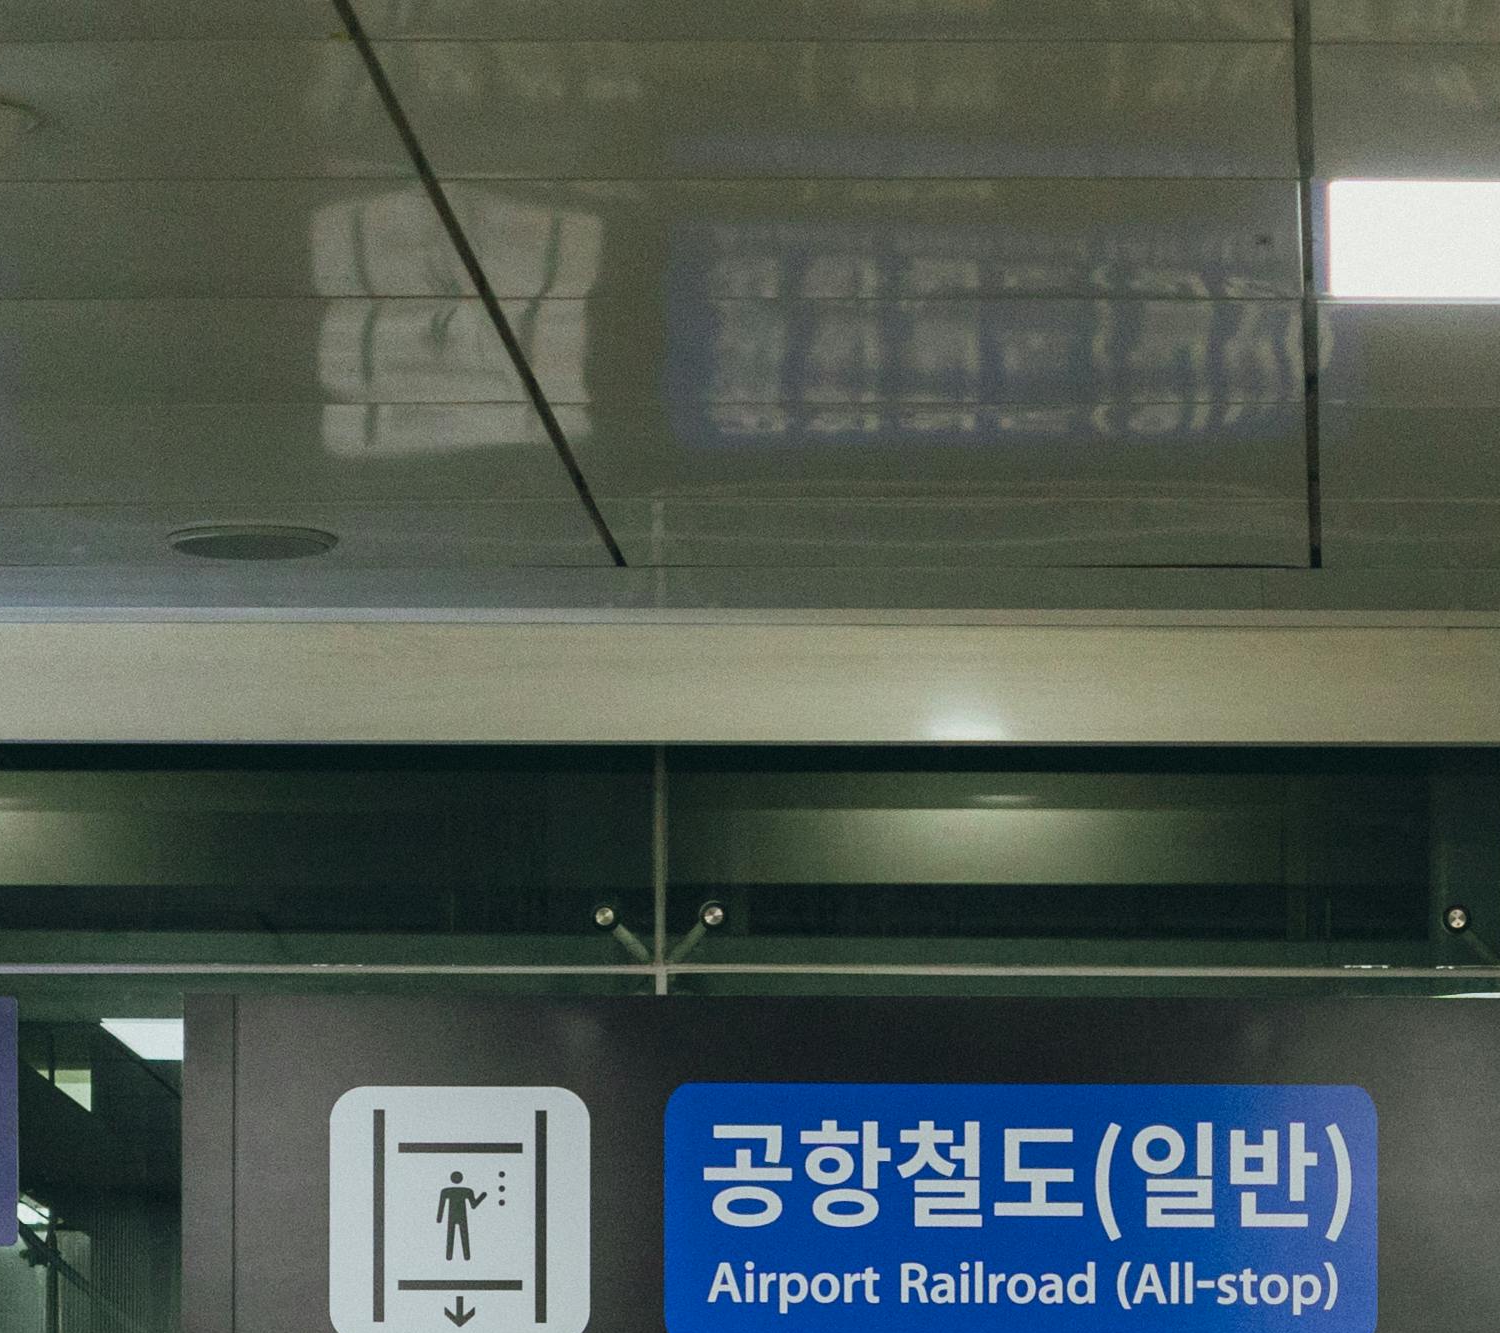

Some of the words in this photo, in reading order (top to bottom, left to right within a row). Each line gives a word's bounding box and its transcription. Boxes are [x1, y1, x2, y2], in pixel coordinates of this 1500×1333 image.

[702, 1119, 1354, 1243] 공항철도(일반)
[707, 1261, 880, 1314] Airport
[900, 1261, 1097, 1306] Railroad
[1116, 1261, 1340, 1316] (All-stop)
